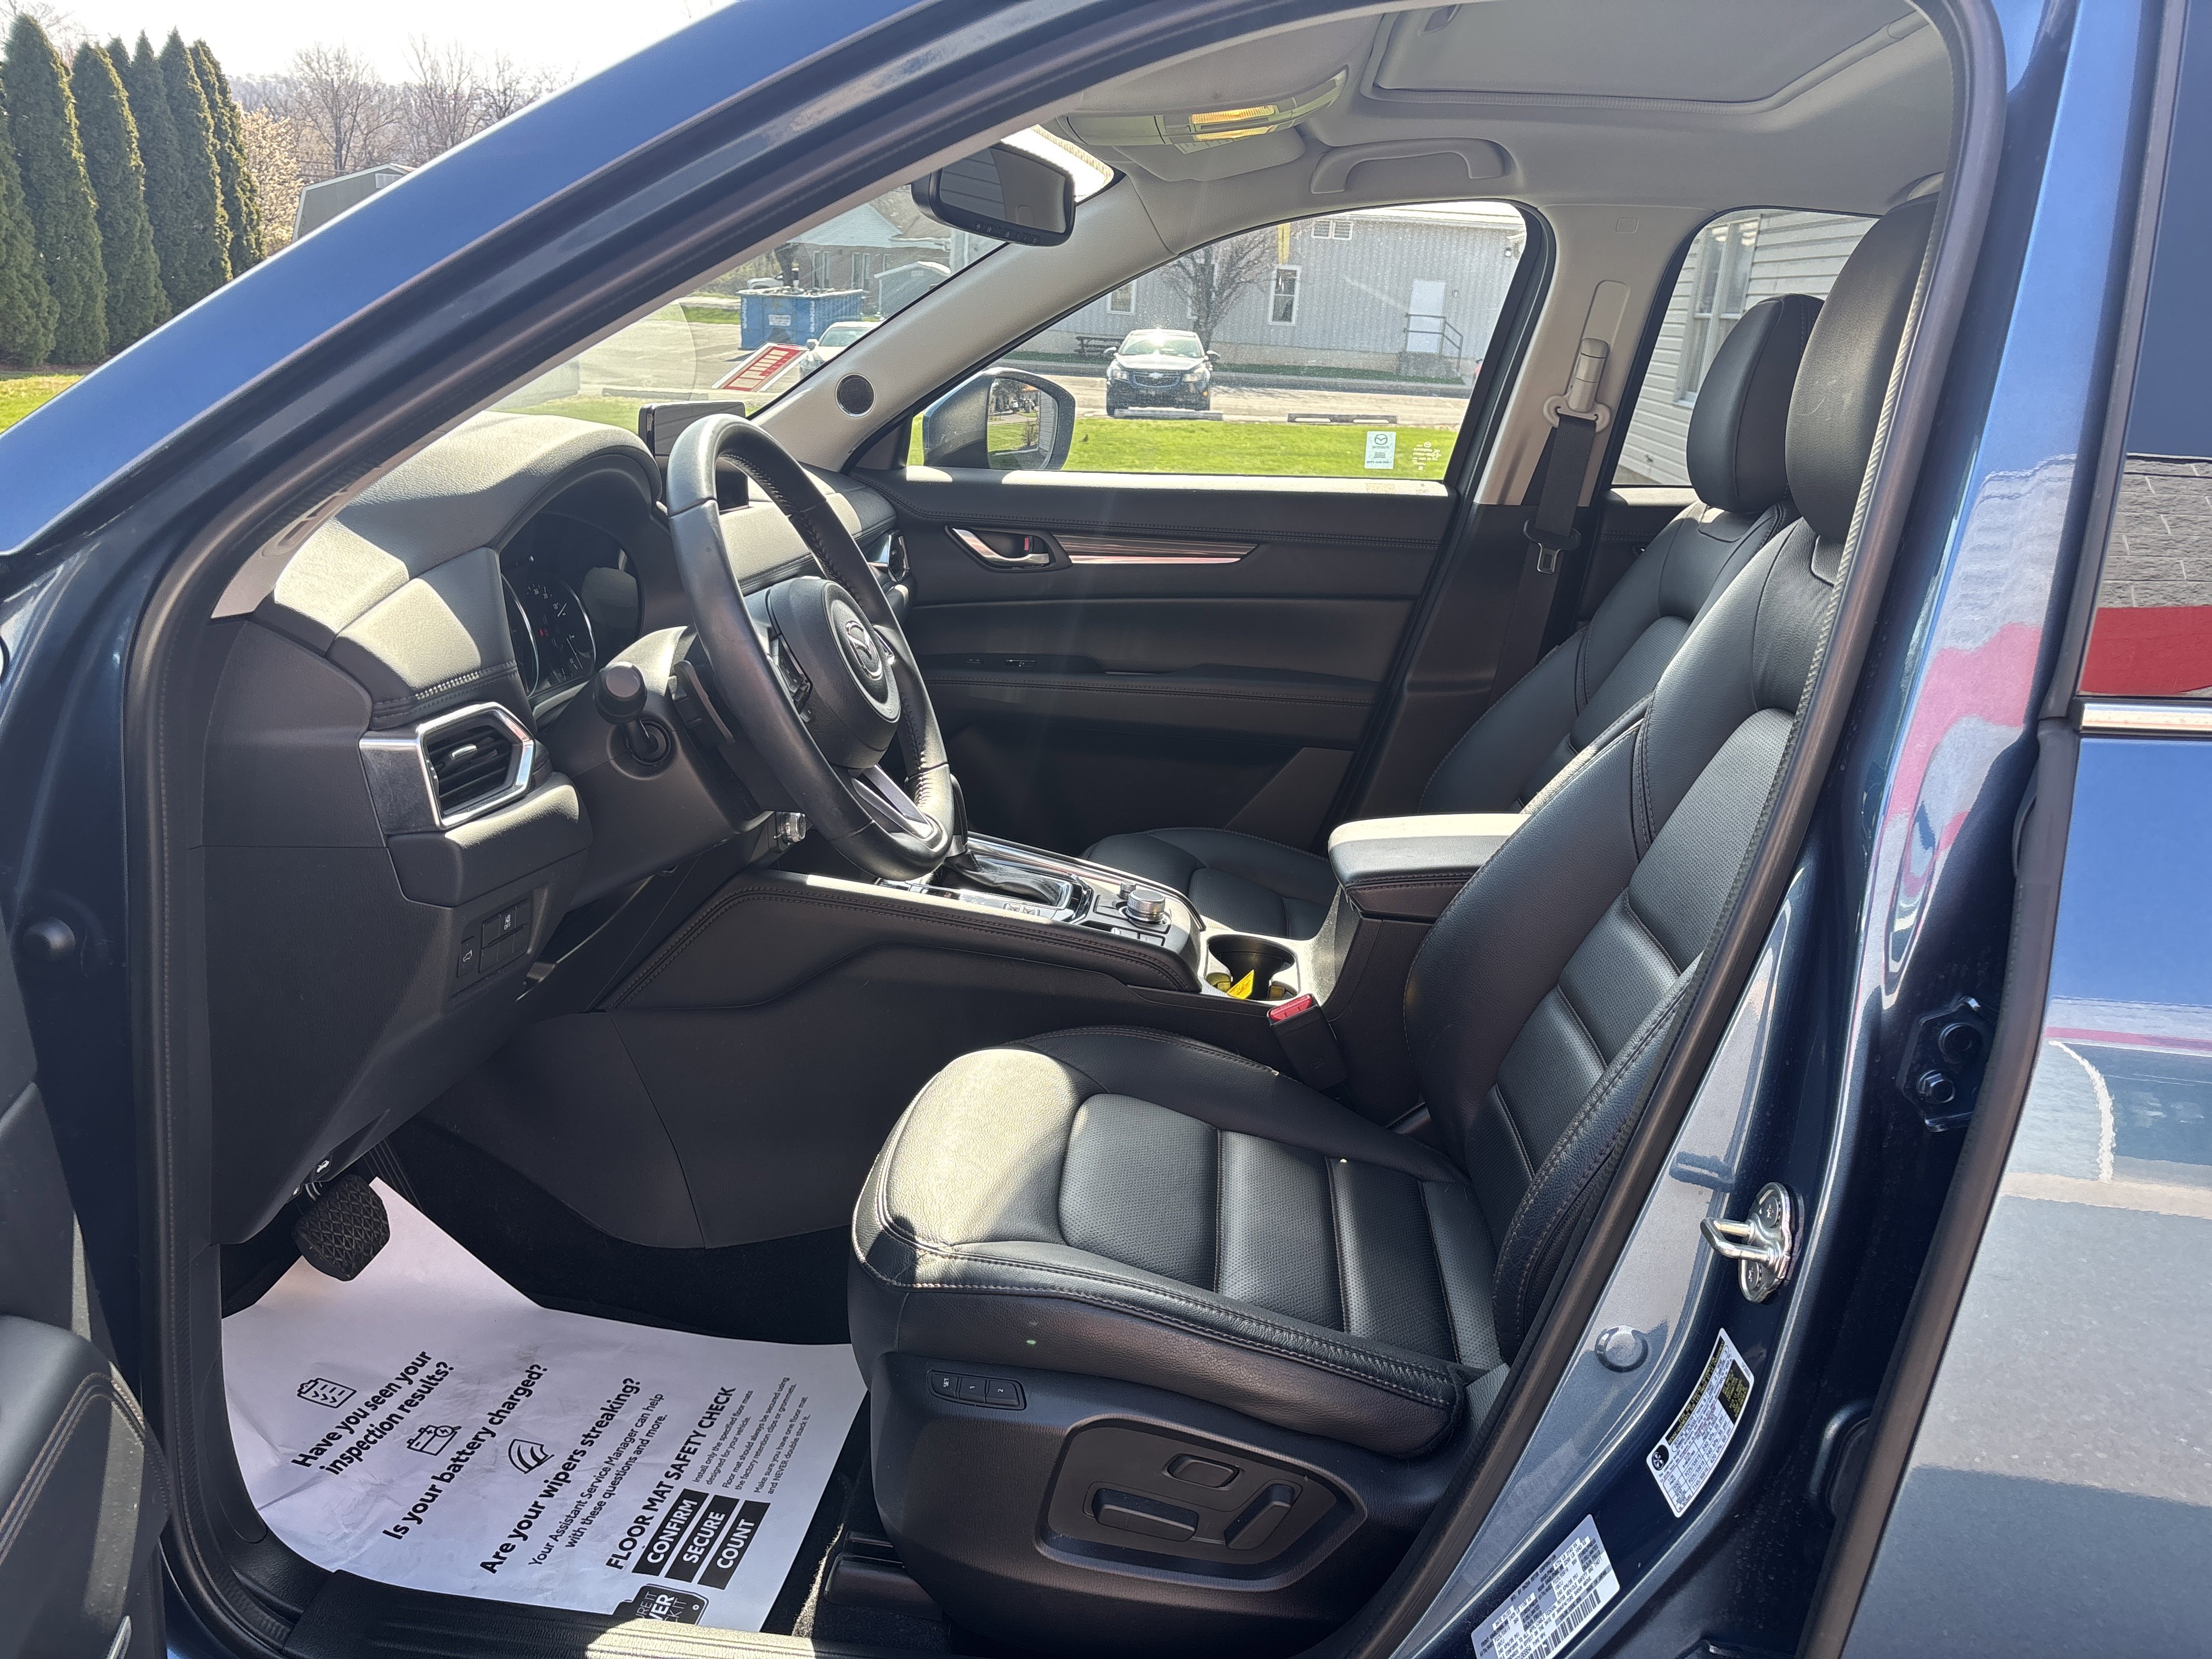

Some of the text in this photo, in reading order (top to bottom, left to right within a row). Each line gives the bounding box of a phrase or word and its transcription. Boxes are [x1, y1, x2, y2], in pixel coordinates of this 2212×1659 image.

[290, 1351, 432, 1468] Have you seen your
[318, 1361, 454, 1475] inspection results?
[785, 1423, 795, 1435] one
[789, 1408, 802, 1423] floor
[795, 1420, 808, 1436] stack
[381, 1364, 548, 1540] Is your battery charged?
[691, 1390, 753, 1483] Install only the specified floor mats
[705, 1416, 752, 1485] designed for your vehicle.
[721, 1472, 736, 1488] Floor
[732, 1460, 744, 1472] mat
[738, 1441, 754, 1461] should
[758, 1414, 769, 1423] be
[734, 1480, 746, 1490] the
[740, 1459, 759, 1480] factory
[753, 1433, 771, 1459] retention
[771, 1451, 781, 1463] you
[775, 1435, 789, 1450] have
[783, 1437, 800, 1459] double
[479, 1378, 641, 1574] Are your wipers streaking?
[527, 1393, 664, 1565] Your Assistant Service Manager can help
[565, 1414, 668, 1548] with these questions and more.
[605, 1386, 736, 1570] FLOOR MAT SAFETY CHECK
[753, 1476, 768, 1493] Make
[764, 1463, 775, 1476] sure
[767, 1481, 778, 1494] and
[772, 1459, 789, 1481] NEVER
[646, 1499, 698, 1563] CONFIRM
[682, 1511, 725, 1564] SECURE
[716, 1518, 755, 1568] COUNT
[644, 1591, 657, 1601] IT
[672, 1598, 687, 1609] IT
